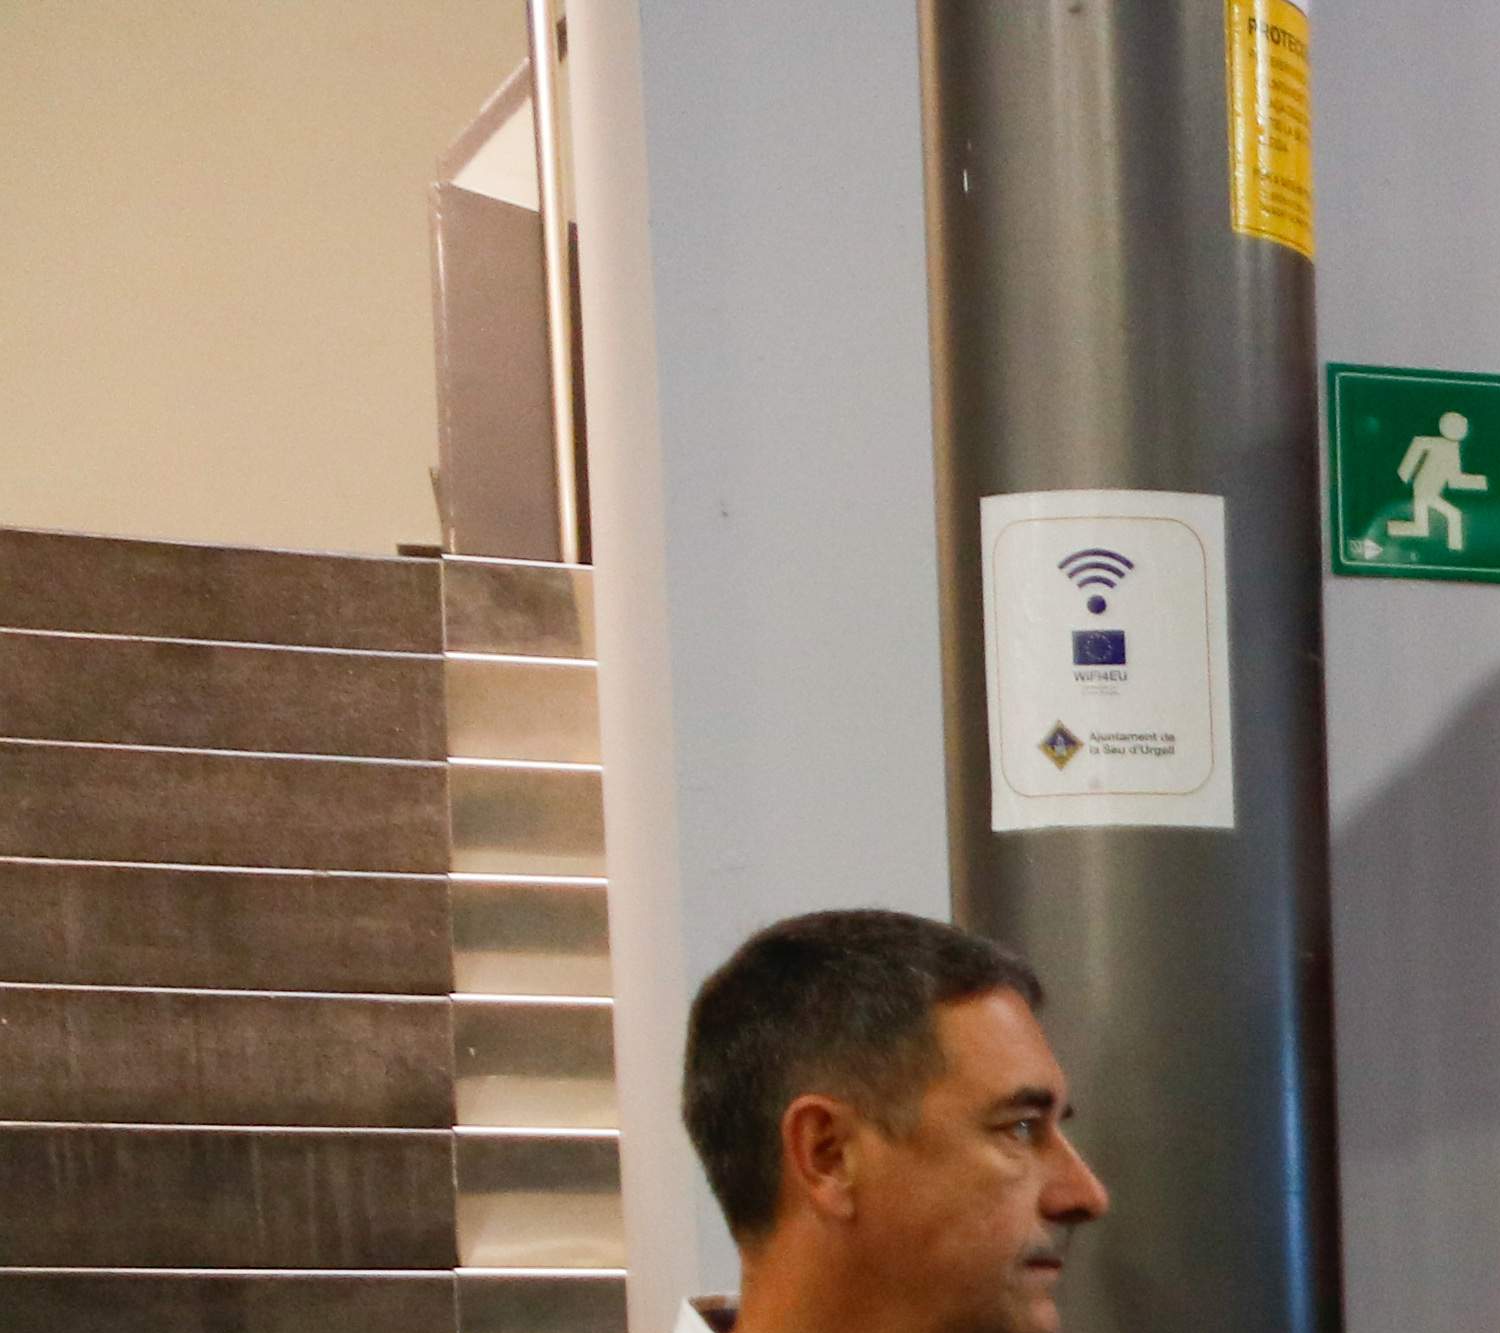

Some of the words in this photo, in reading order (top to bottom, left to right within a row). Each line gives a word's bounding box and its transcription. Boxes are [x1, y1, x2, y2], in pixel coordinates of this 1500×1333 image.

[1089, 731, 1157, 743] Ajuntament
[1160, 732, 1175, 742] de
[1103, 745, 1126, 755] Seu
